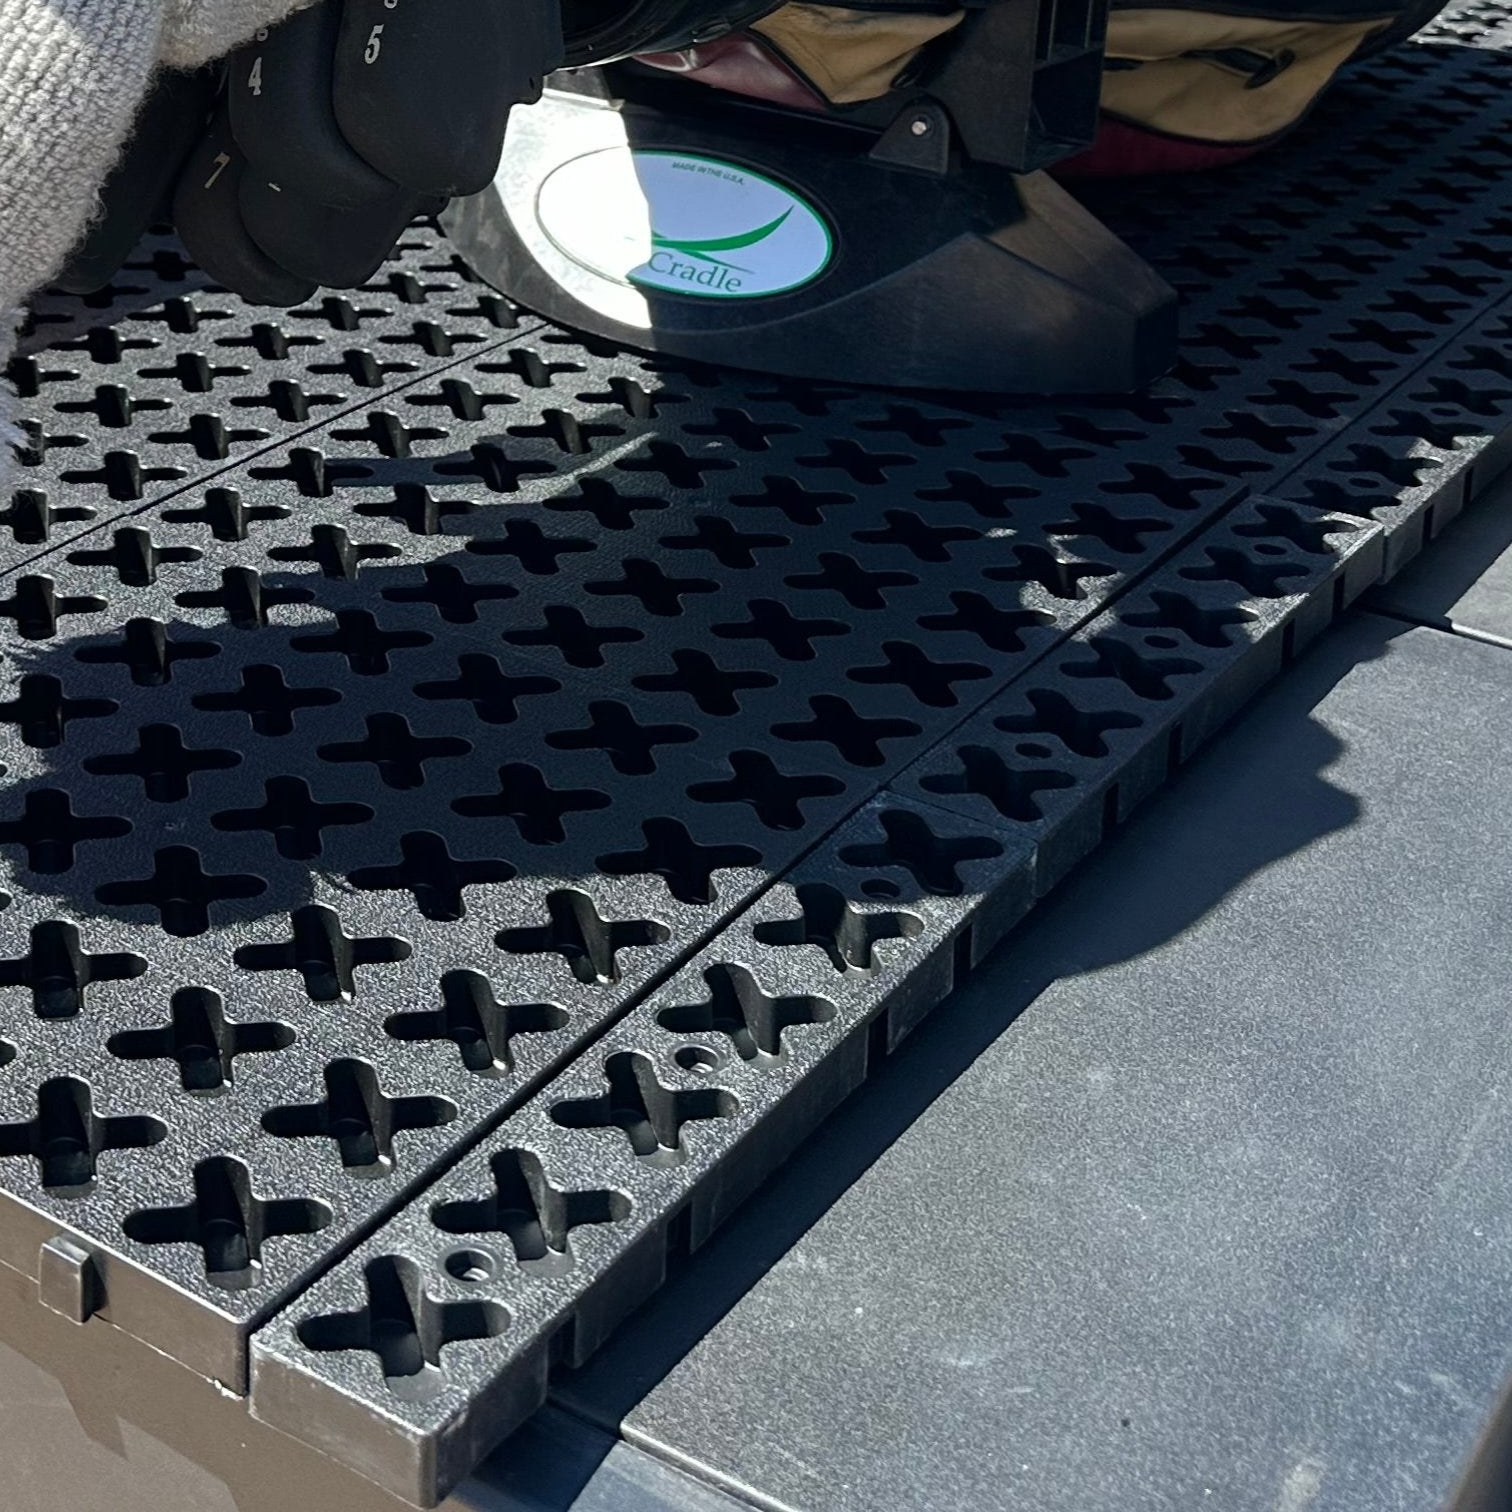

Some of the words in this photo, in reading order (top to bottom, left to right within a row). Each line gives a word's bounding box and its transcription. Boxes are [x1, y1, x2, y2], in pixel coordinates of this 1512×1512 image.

[364, 24, 385, 64] 5
[248, 56, 263, 96] 4
[204, 152, 231, 189] 7
[672, 161, 696, 172] MADE
[648, 251, 742, 293] Cradle
